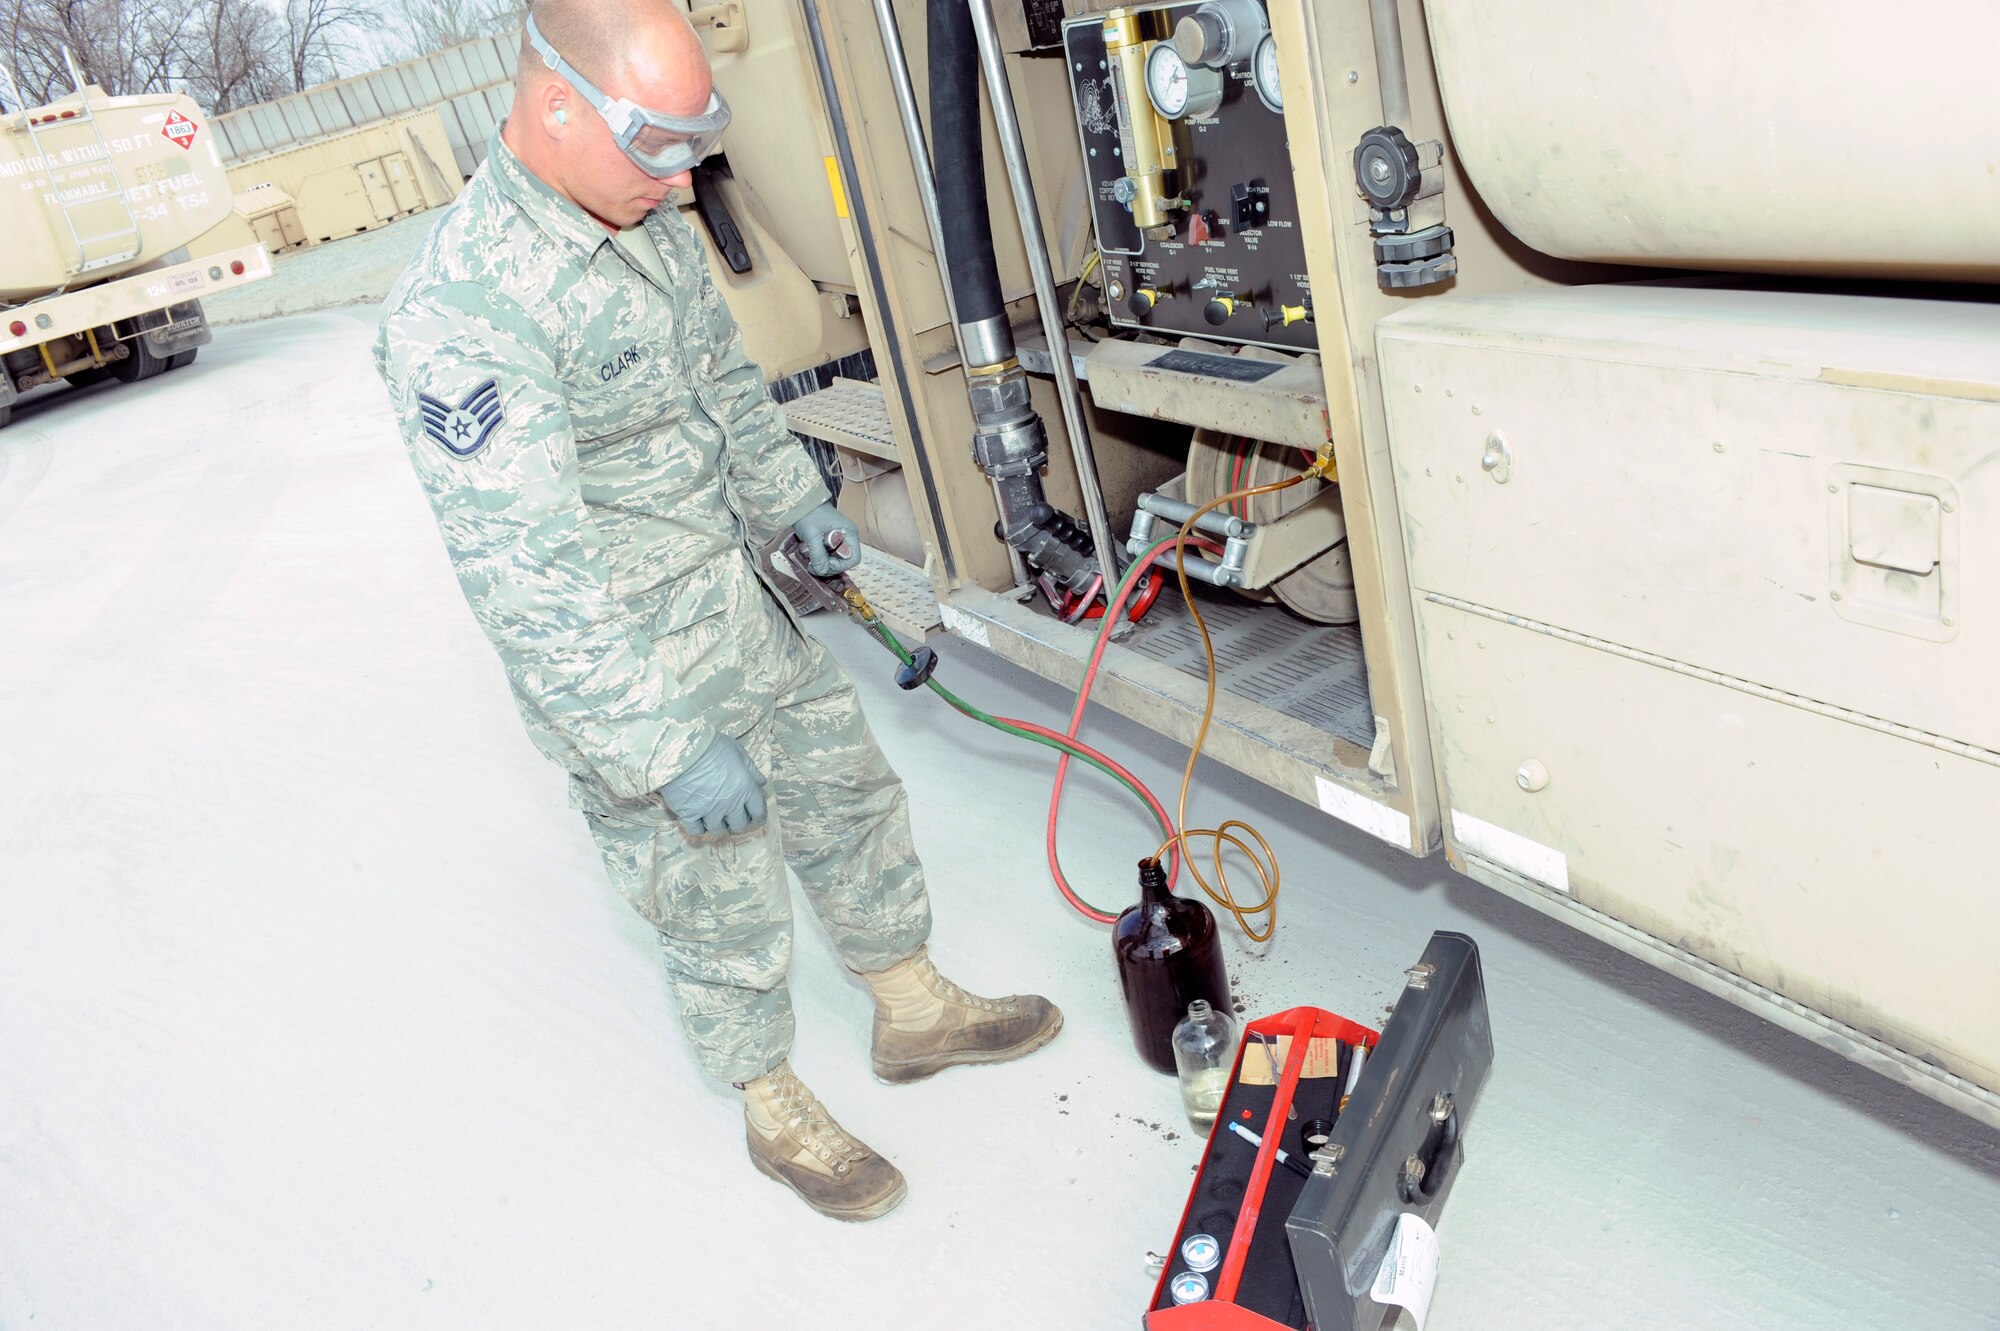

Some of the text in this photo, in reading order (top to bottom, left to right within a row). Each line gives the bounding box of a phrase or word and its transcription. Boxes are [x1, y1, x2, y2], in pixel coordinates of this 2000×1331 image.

[169, 124, 192, 135] 1863
[112, 138, 132, 153] 50
[181, 137, 188, 146] 3
[157, 171, 204, 194] FUEL
[600, 344, 641, 382] CLARK
